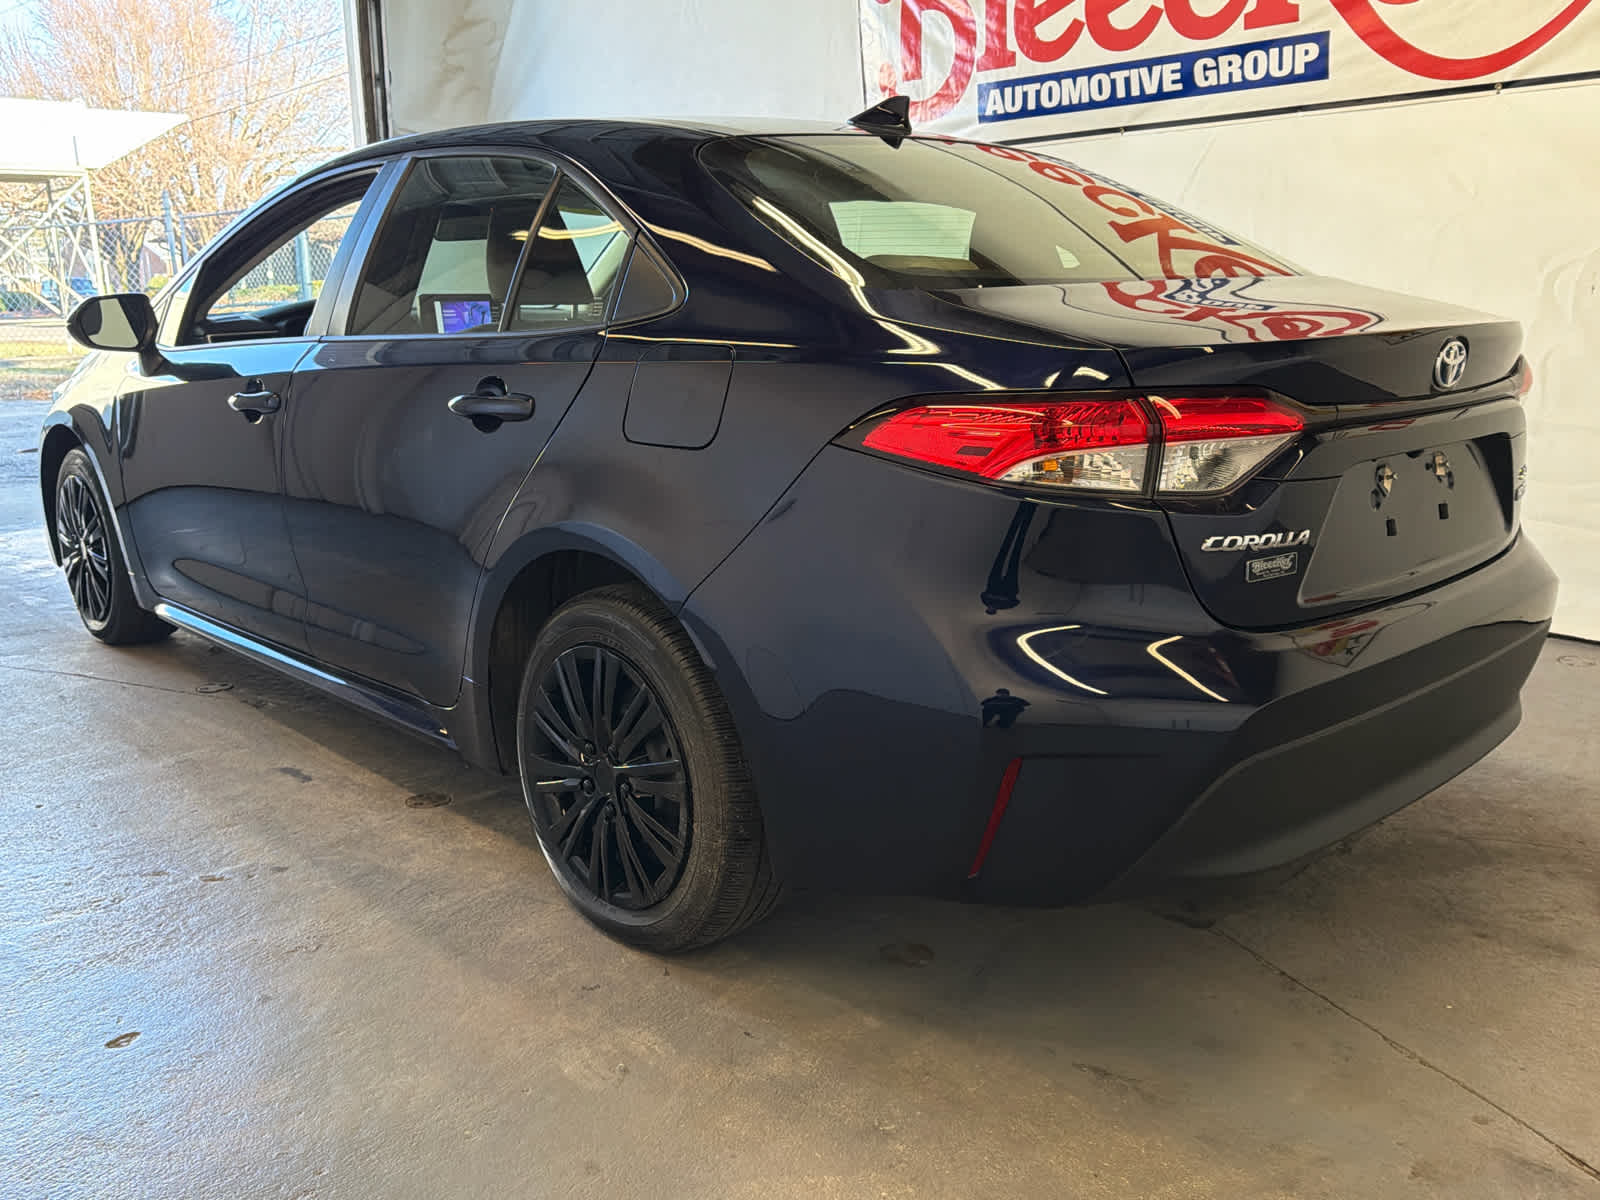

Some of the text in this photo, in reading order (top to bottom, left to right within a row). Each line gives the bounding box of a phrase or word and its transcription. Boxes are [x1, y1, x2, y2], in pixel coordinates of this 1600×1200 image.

[985, 42, 1320, 117] AUTOMOTIVE GROUP
[1201, 529, 1311, 551] COROLLA
